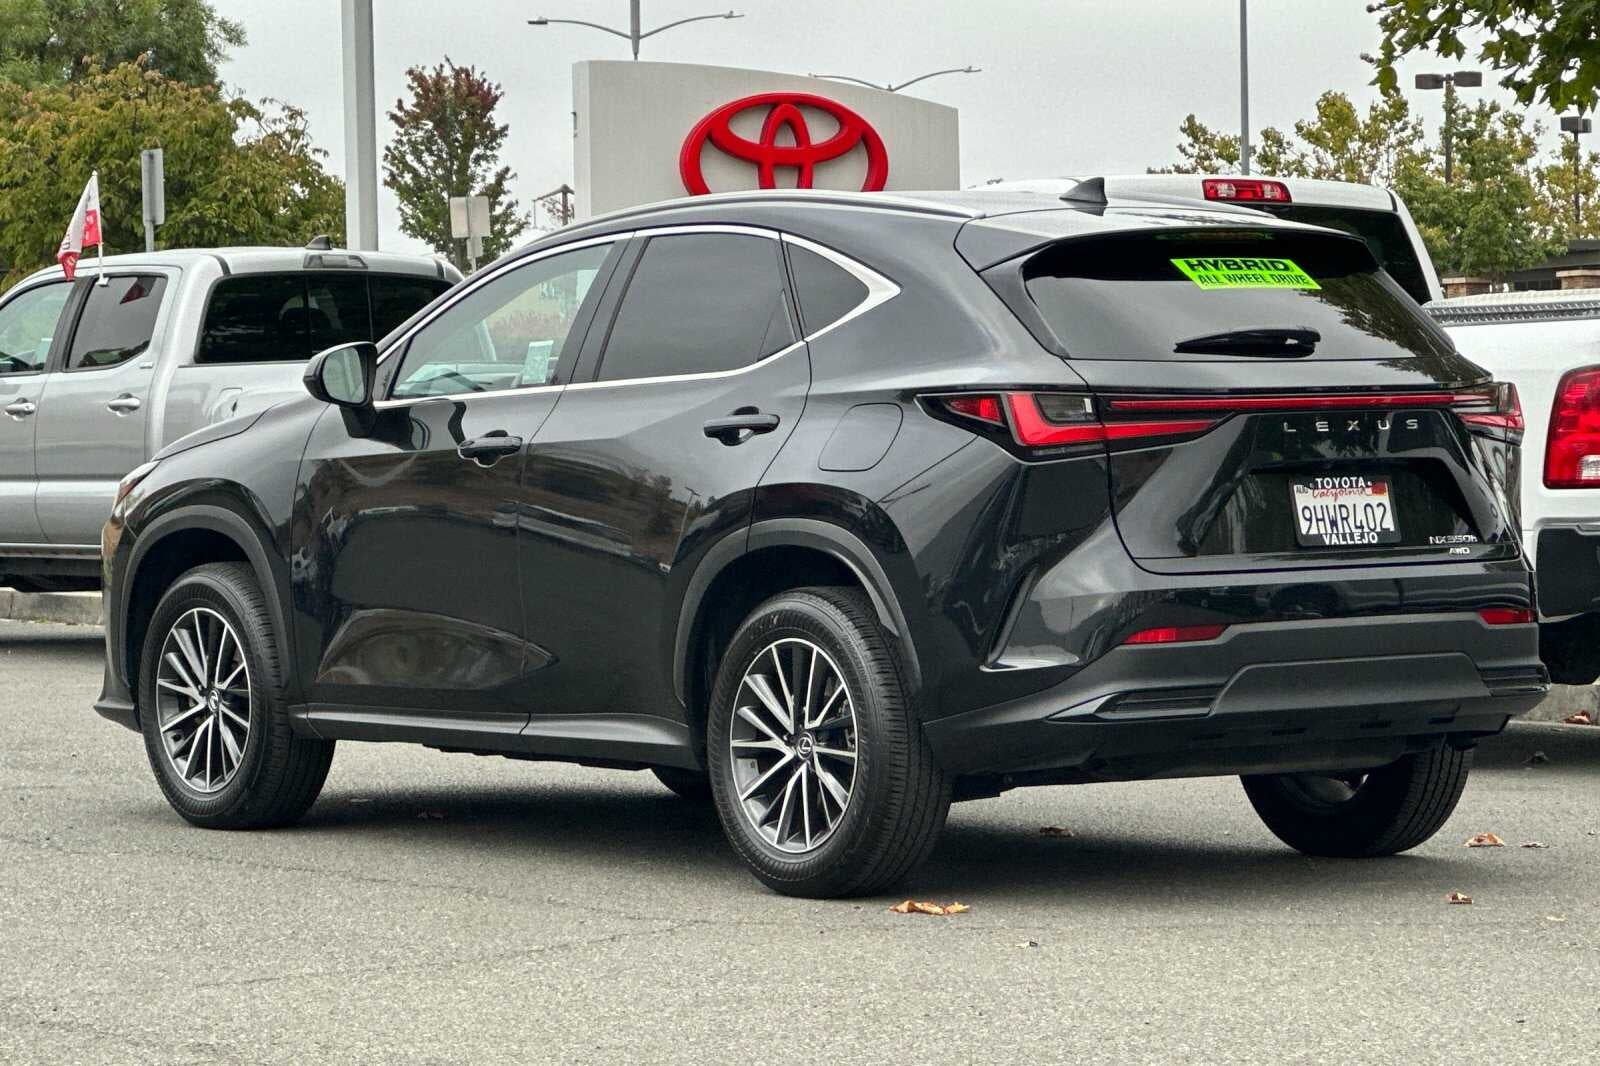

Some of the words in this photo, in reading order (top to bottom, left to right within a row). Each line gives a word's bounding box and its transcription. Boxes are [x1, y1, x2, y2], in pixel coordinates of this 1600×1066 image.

[1184, 259, 1289, 272] HYBRID
[1198, 274, 1223, 284] ALL
[1224, 274, 1270, 284] WHEEL
[1271, 274, 1310, 284] DRIVE
[1283, 419, 1418, 432] LEXUS
[1315, 476, 1366, 489] TOYOTA
[1322, 532, 1378, 545] VALLEJO
